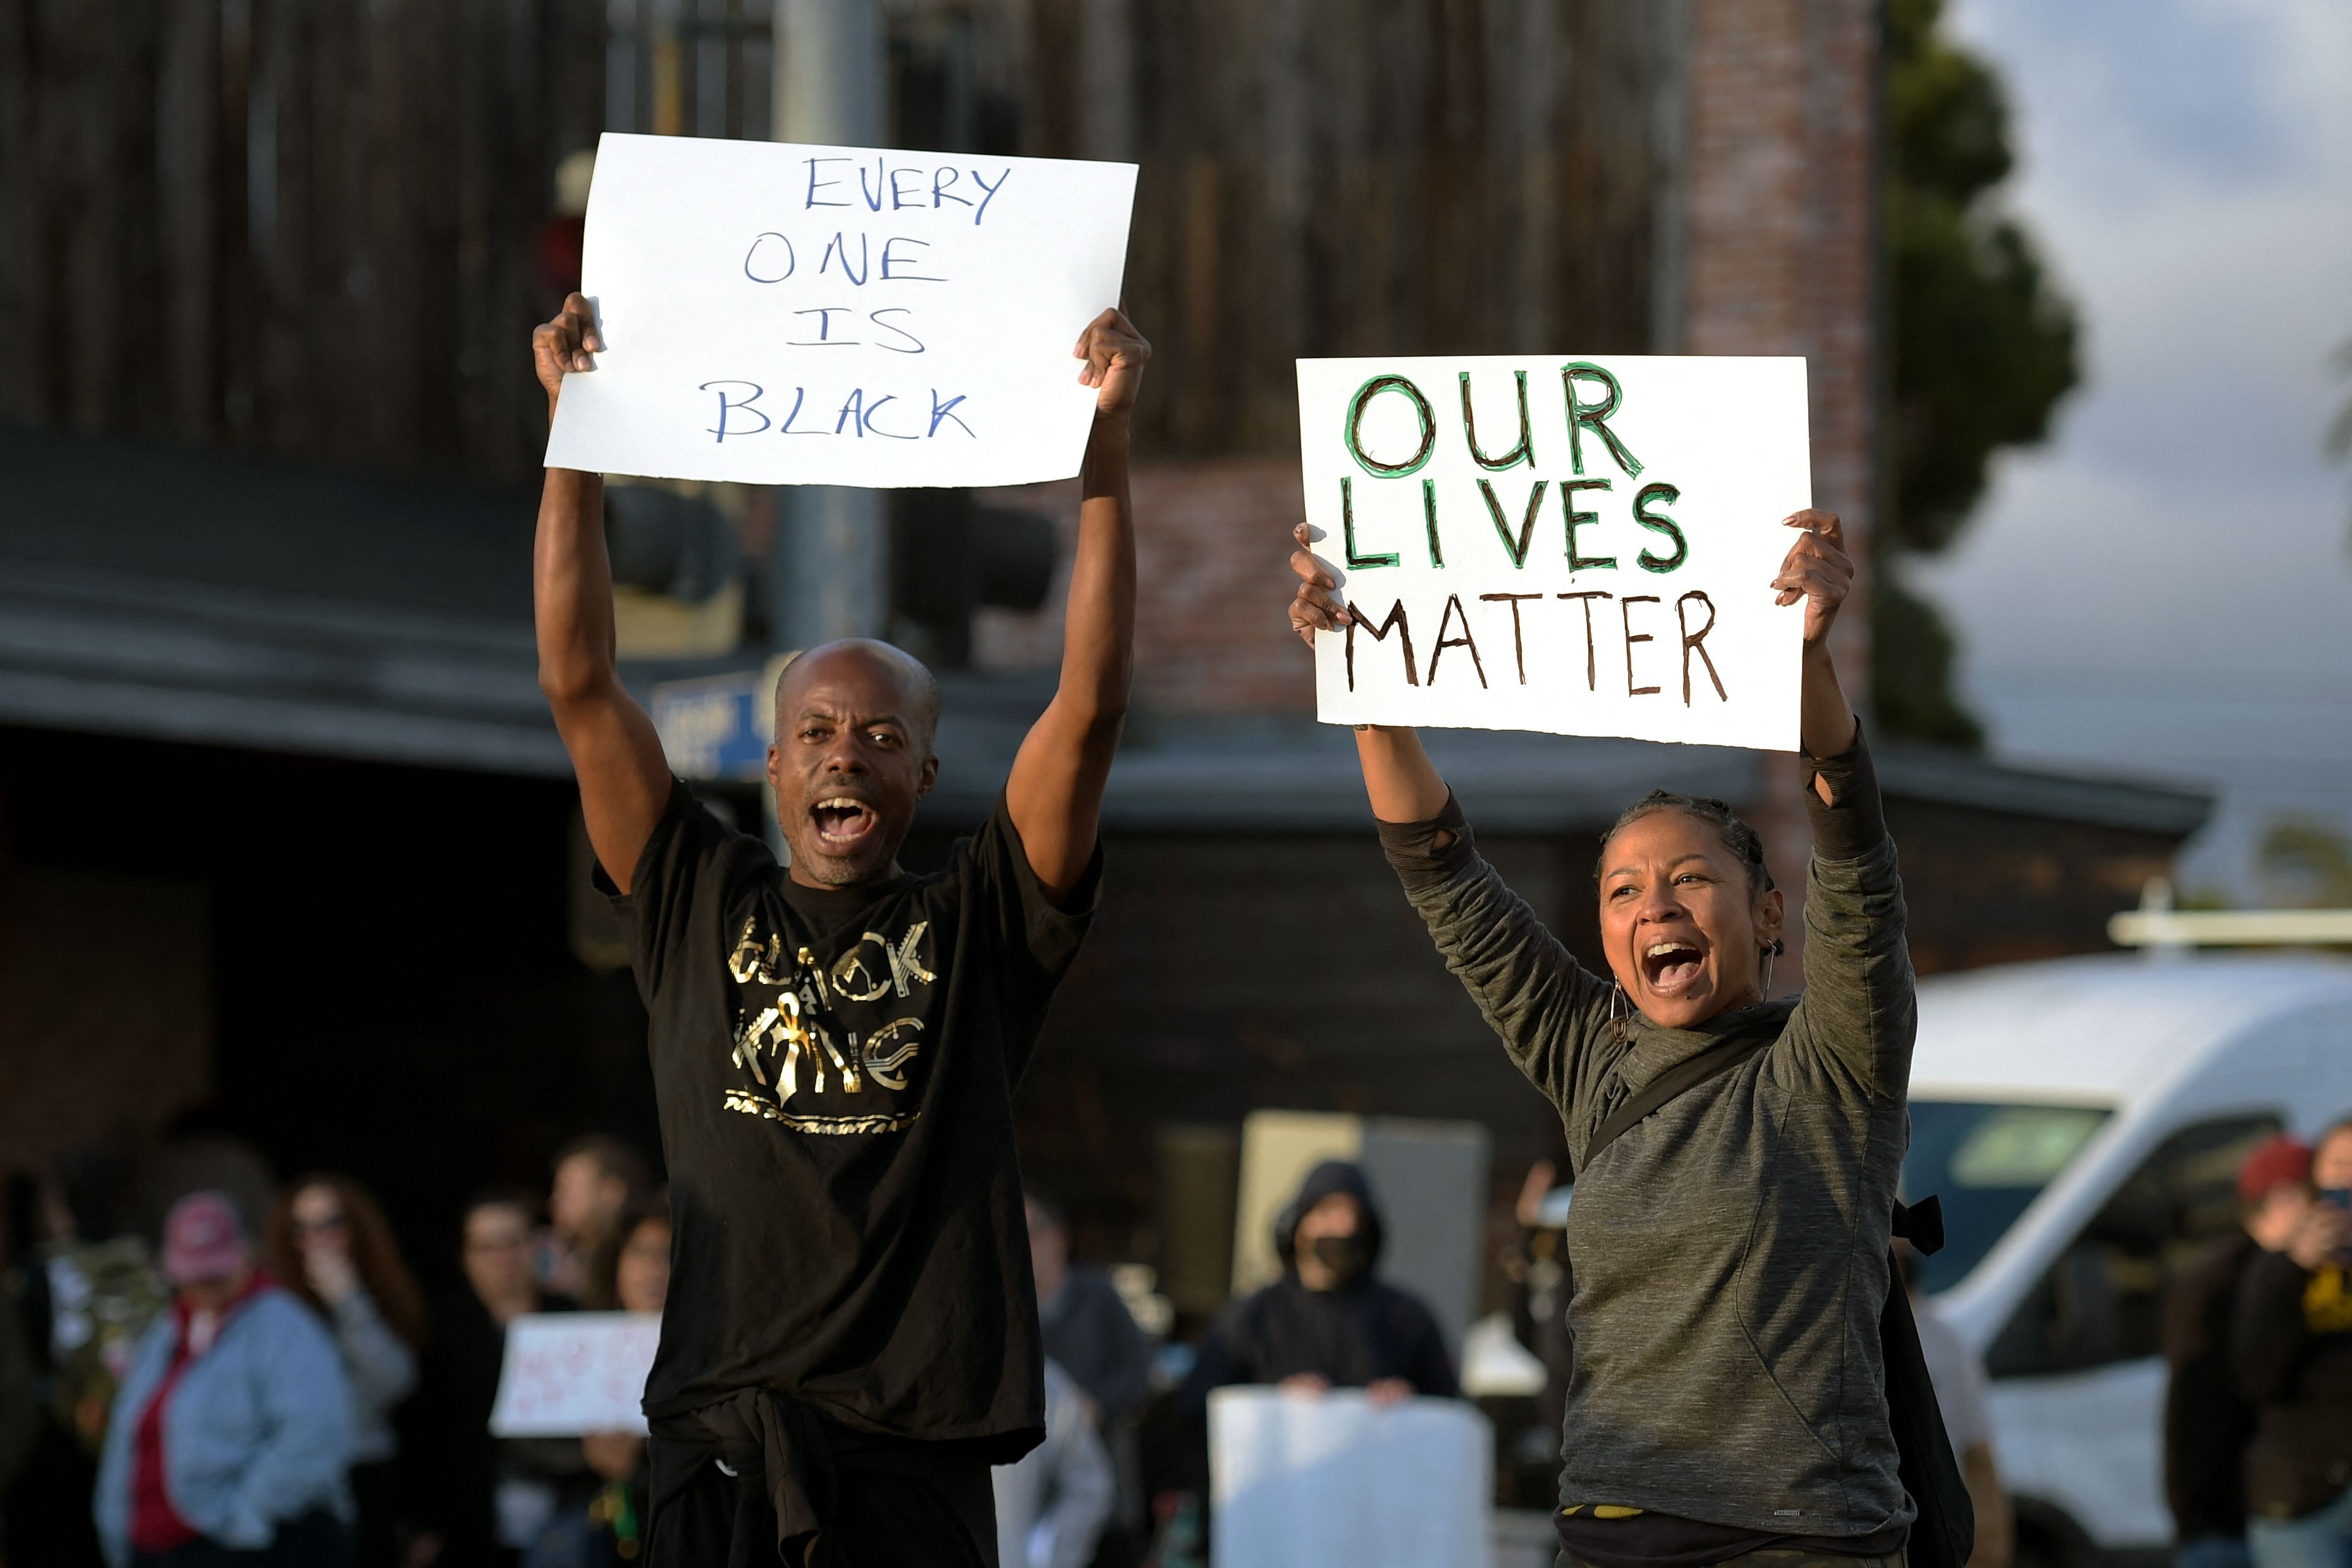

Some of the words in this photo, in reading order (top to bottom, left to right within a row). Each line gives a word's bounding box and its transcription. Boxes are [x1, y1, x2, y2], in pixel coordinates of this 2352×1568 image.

[802, 157, 1010, 225] EVERY
[744, 232, 949, 285] ONE
[785, 308, 925, 354] IS
[699, 381, 977, 443] BLACK
[1344, 361, 1645, 479] OUR
[1340, 476, 1689, 574] LIVES
[1347, 591, 1728, 709] MATTER
